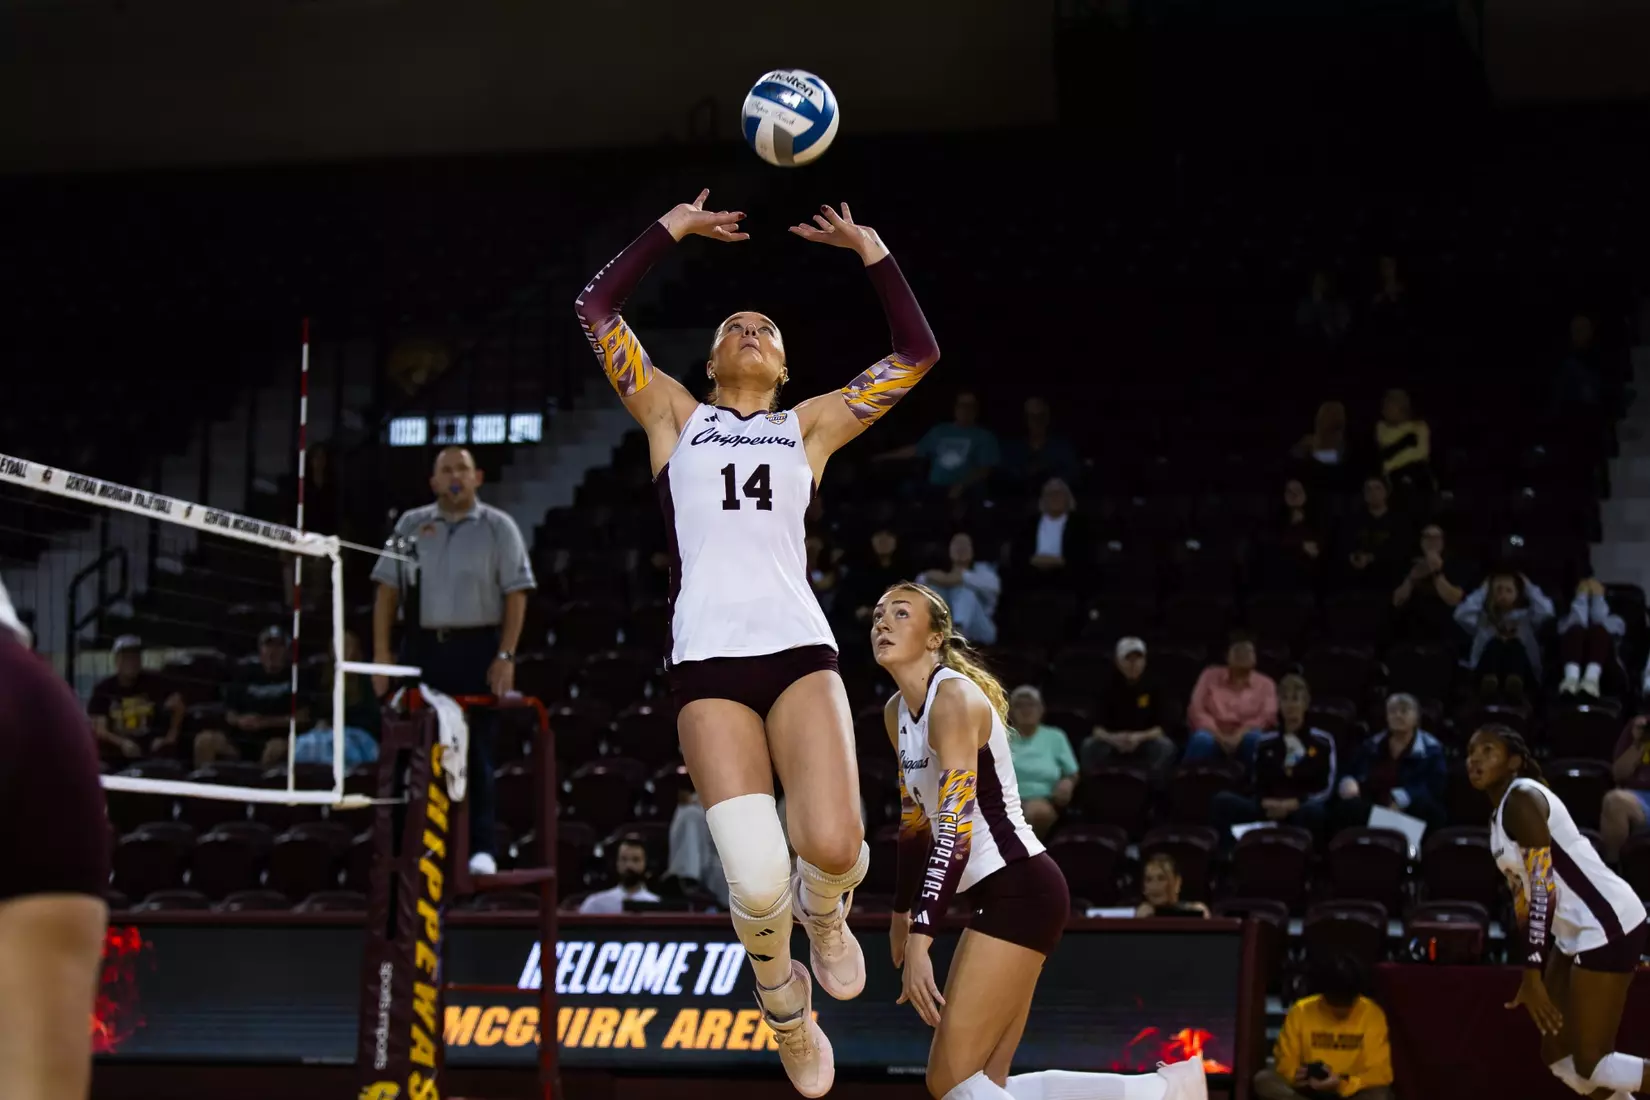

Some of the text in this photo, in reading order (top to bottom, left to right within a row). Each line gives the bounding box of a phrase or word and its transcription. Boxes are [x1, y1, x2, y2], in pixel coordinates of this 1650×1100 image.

[690, 427, 796, 448] Chippewas
[0, 457, 28, 479] EYBALL
[720, 463, 773, 511] 14
[921, 811, 957, 901] CHIPPEWAS
[407, 742, 450, 1100] CHIPPEWAS
[517, 941, 747, 996] WELCOME TO
[661, 1008, 819, 1052] AREN
